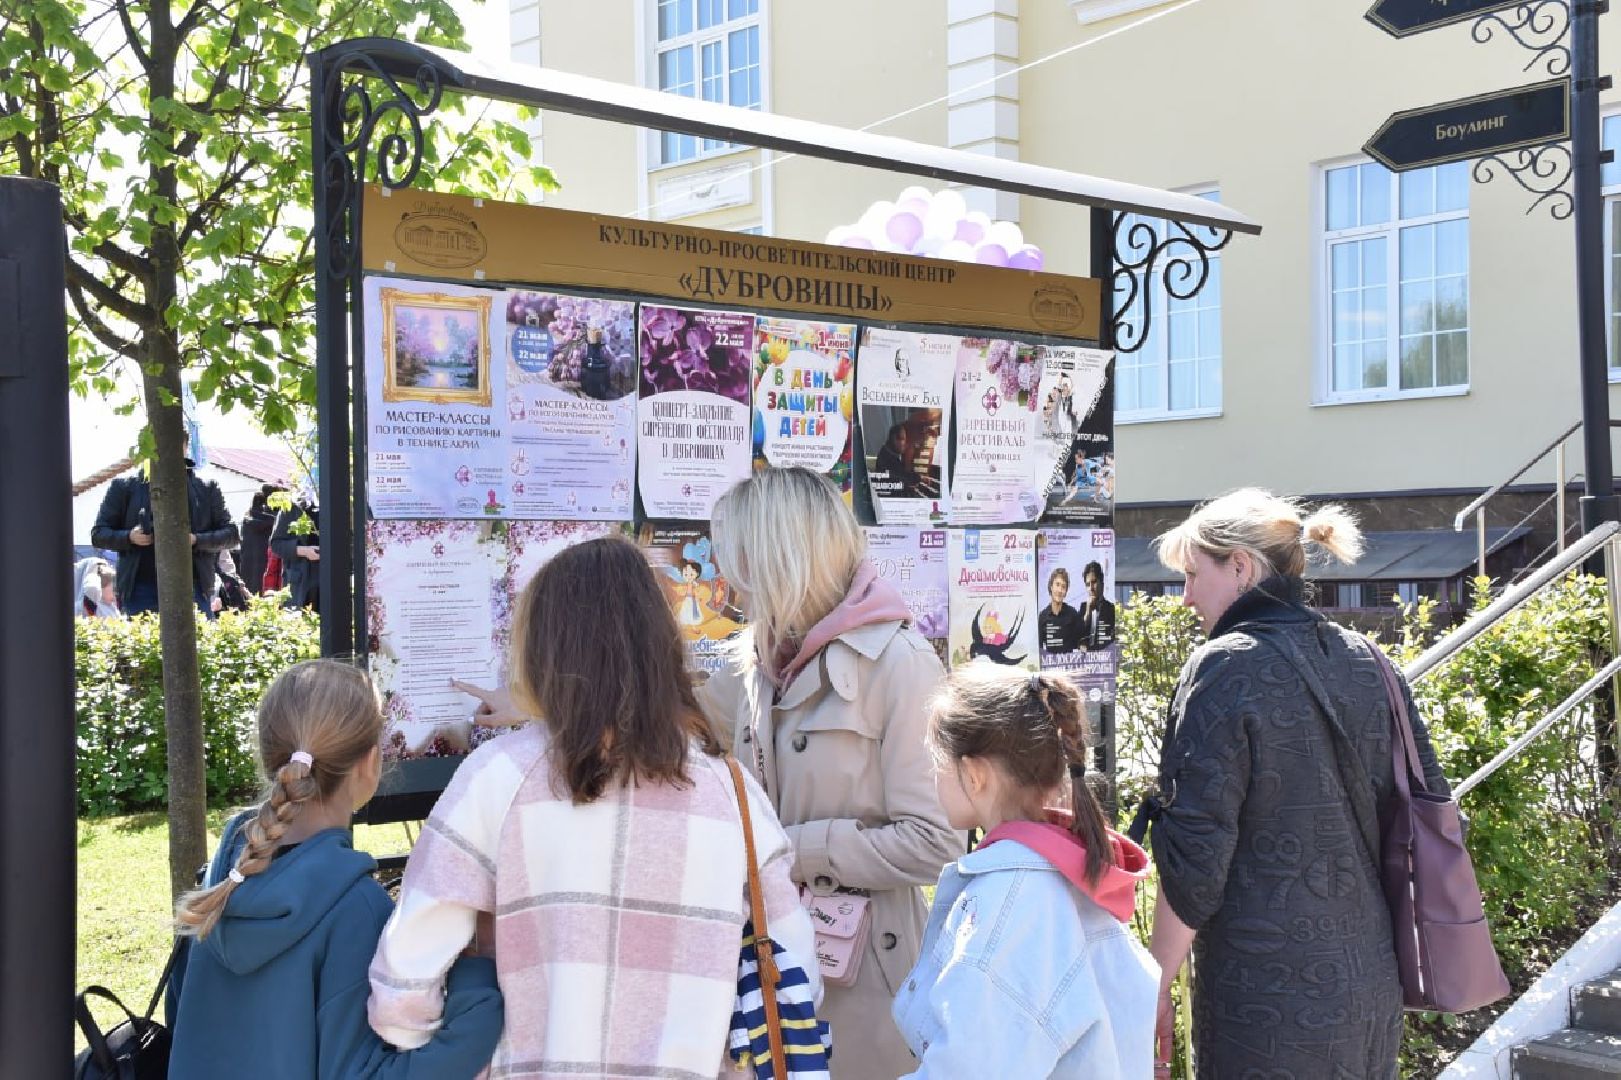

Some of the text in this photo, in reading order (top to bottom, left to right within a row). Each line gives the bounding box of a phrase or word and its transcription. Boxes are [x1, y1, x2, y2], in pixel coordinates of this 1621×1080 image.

[1436, 115, 1507, 141] Боулинг
[599, 224, 955, 284] КУЛЬТУРНО-ПРОСВЕТИТЕЛЬСКИЙ ЦЕНТР
[678, 266, 893, 312] «ДУБРОВИЦЫ»
[715, 332, 729, 346] 22
[818, 331, 826, 347] 1
[827, 339, 849, 349] ИЮНЯ
[774, 368, 833, 389] В ДЕНЬ
[535, 400, 608, 412] МАСТЕР-КЛАССЫ
[652, 401, 735, 423] КОНЦЕРТ-ЗАКРЫТИЕ
[767, 391, 838, 414] ЗАЩИТЫ
[385, 410, 491, 426] МАСТЕР-КЛАССЫ
[779, 414, 827, 438] ДЕТЕЙ
[375, 425, 500, 438] ПО РИСОВАНИЮ КАРТИНЫ
[696, 424, 744, 445] ФЕСТИВАЛЯ
[408, 439, 448, 449] ТЕХНИКЕ
[451, 440, 480, 449] АКРИЛ
[969, 449, 1022, 464] Дубровицах
[1004, 534, 1017, 550] 22
[1093, 535, 1104, 546] 22
[958, 565, 1029, 586] Дюймовочка
